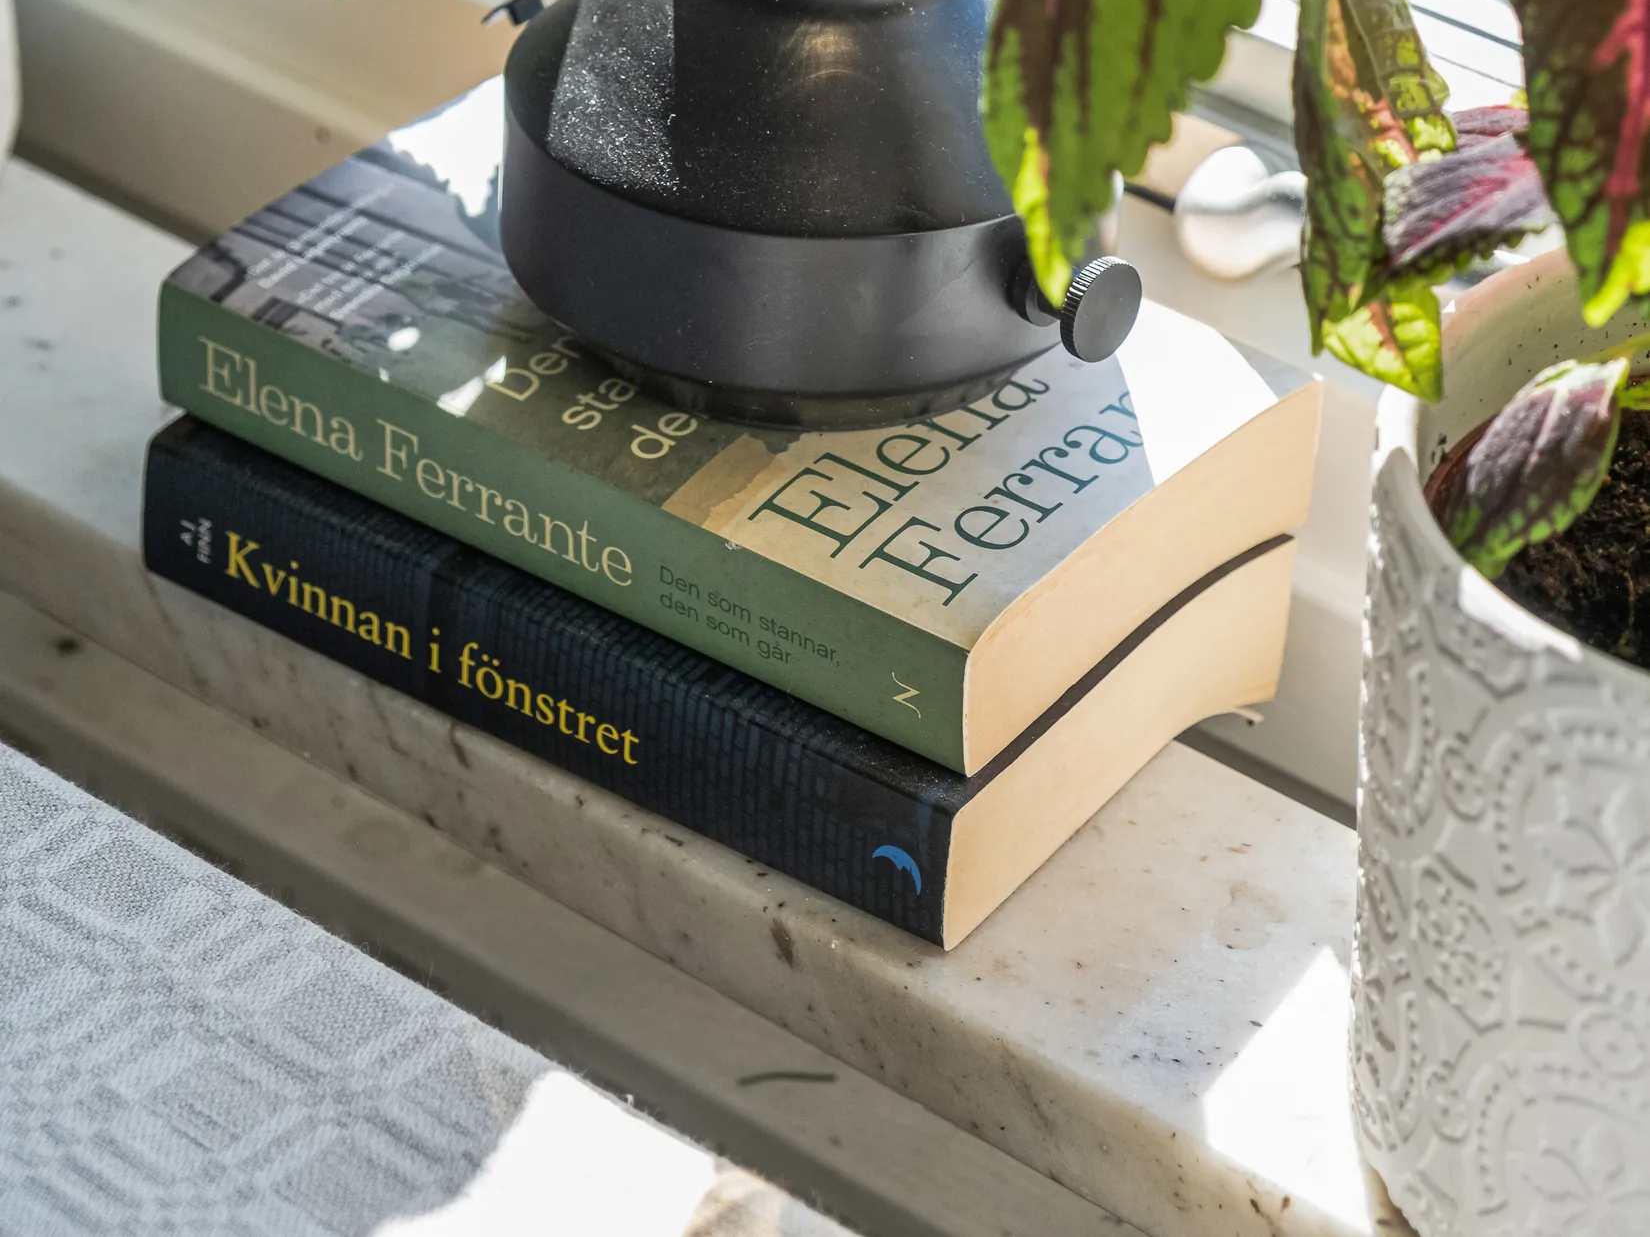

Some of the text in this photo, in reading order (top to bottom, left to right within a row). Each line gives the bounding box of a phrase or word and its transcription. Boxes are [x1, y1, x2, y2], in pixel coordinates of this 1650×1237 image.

[562, 378, 638, 431] sta
[630, 410, 709, 459] de
[198, 335, 634, 588] Elena Ferrante
[225, 530, 640, 765] Kvinnan i fönstret
[659, 565, 841, 667] Den som stannar,
[659, 593, 793, 664] den som går
